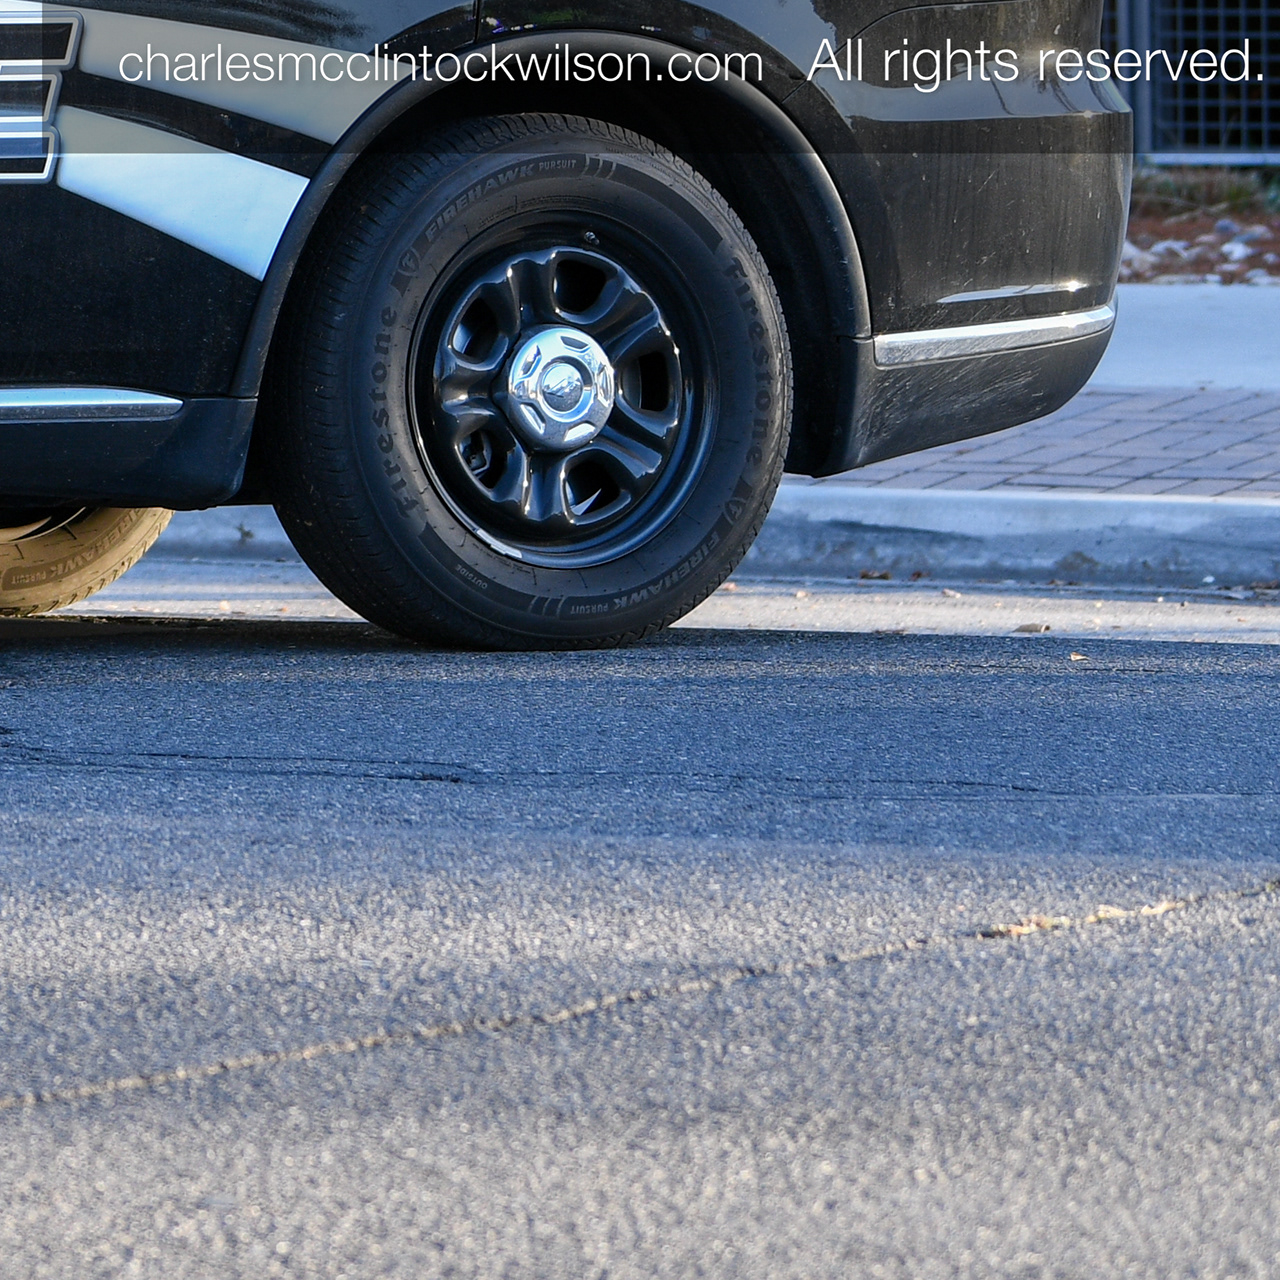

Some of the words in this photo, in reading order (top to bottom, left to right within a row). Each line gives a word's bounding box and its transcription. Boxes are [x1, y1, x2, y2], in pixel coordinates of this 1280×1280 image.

[424, 163, 535, 242] FIREHAWK
[538, 158, 577, 171] PURSUIT
[368, 306, 418, 518] Firestone
[569, 603, 610, 617] PURSUIT
[612, 530, 721, 609] FIREHAWK
